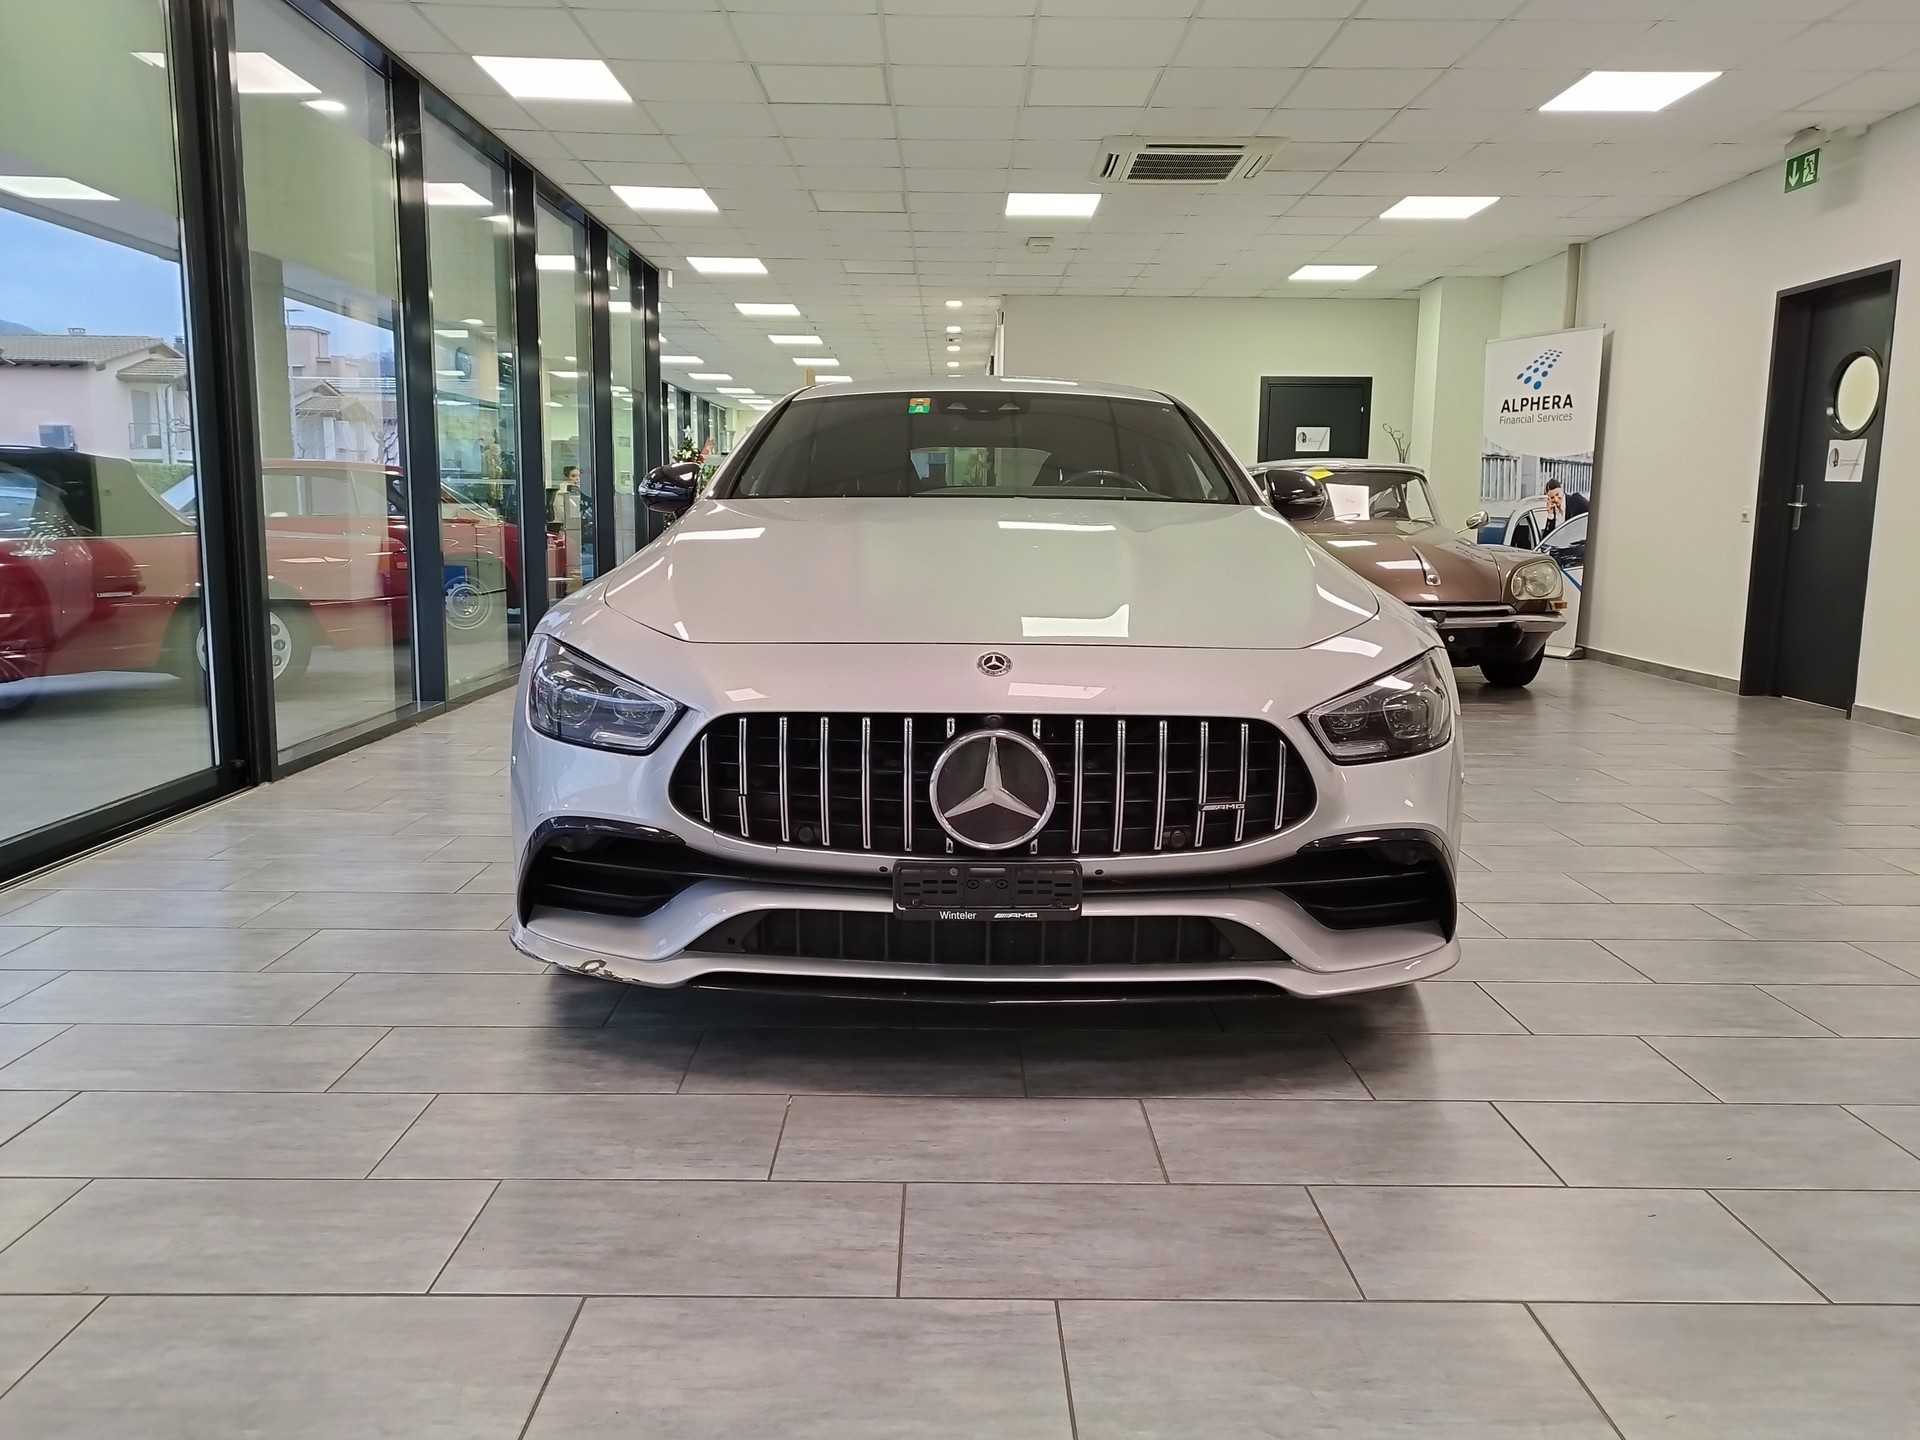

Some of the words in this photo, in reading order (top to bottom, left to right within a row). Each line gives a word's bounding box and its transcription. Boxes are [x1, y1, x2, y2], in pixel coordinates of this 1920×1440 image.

[1500, 394, 1573, 413] ALPHERA
[1499, 414, 1534, 424] Financial
[1537, 412, 1573, 422] Services
[939, 911, 977, 920] Winteler
